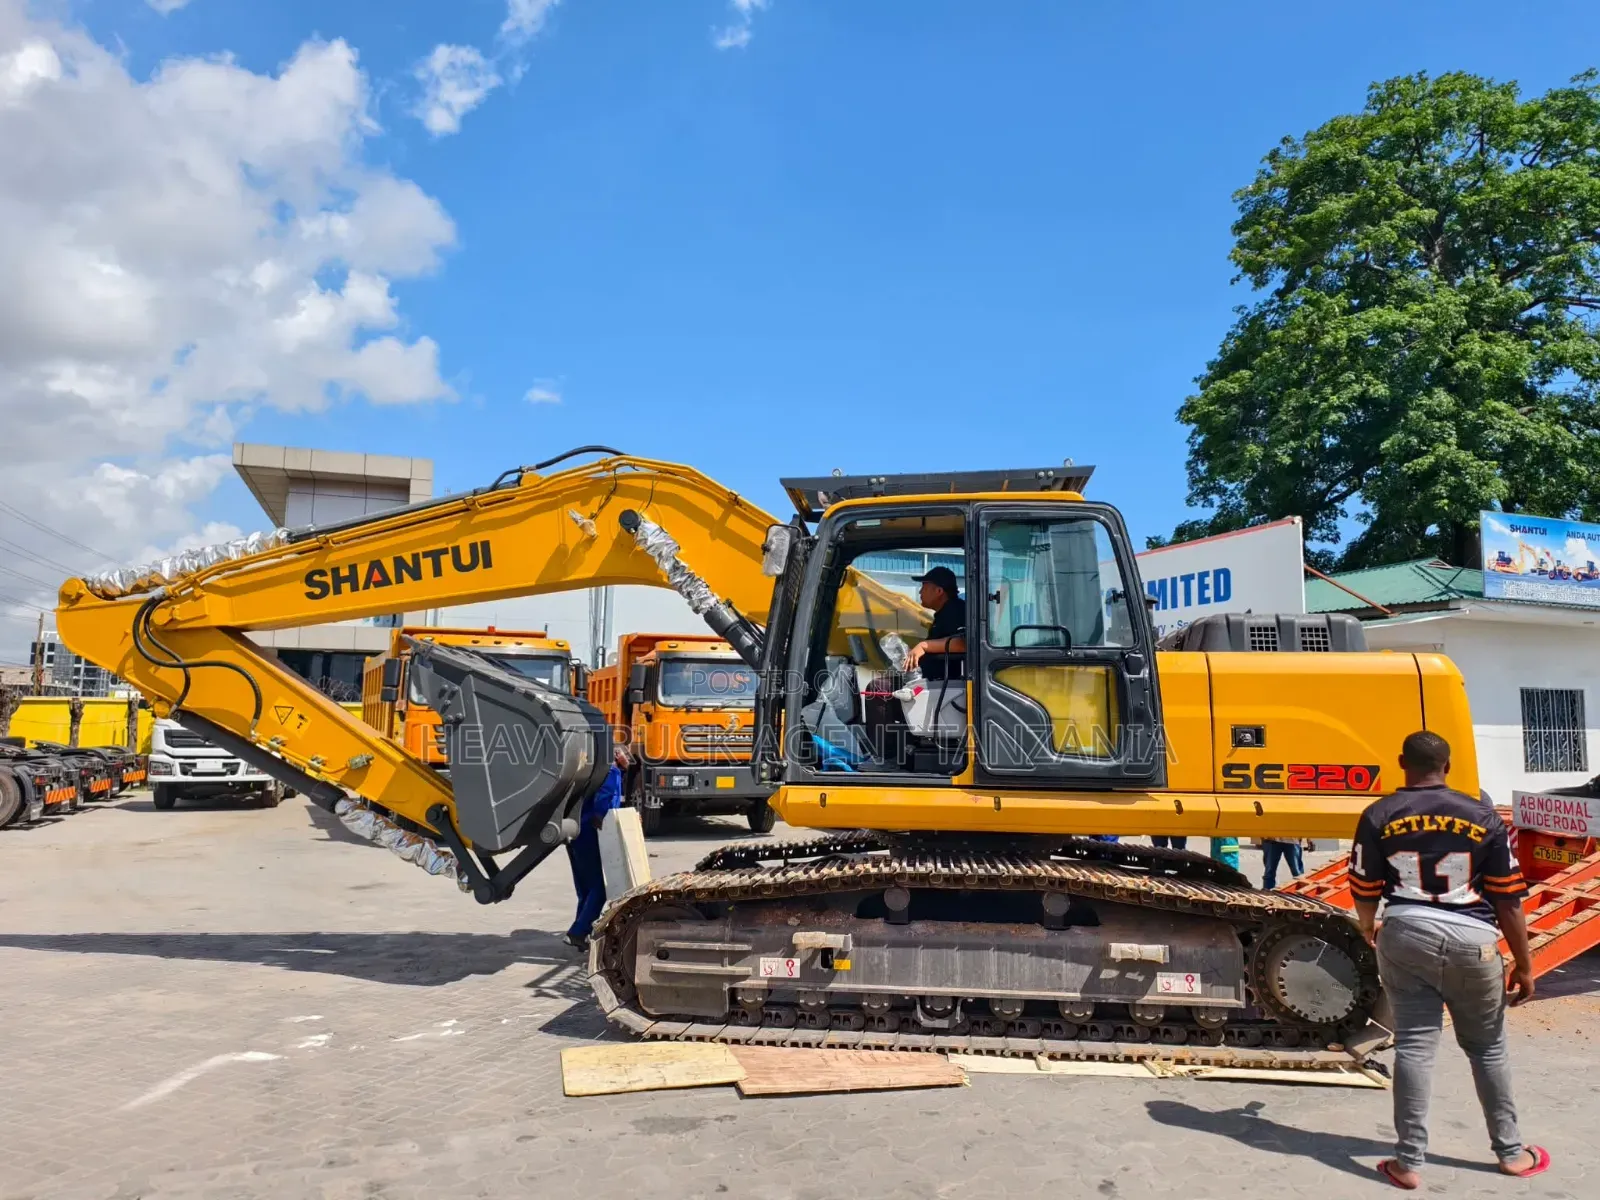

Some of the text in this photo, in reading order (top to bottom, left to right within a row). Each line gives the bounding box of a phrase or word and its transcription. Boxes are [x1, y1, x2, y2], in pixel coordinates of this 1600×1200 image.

[1510, 524, 1547, 536] SHANTUI
[1566, 530, 1586, 541] ANDA
[304, 540, 493, 601] SHANTUI
[1141, 567, 1232, 612] MITED
[1222, 763, 1373, 791] SE220
[1519, 795, 1593, 818] ABNORMAL
[1520, 810, 1588, 833] WIDE ROAD
[1386, 850, 1482, 904] 11
